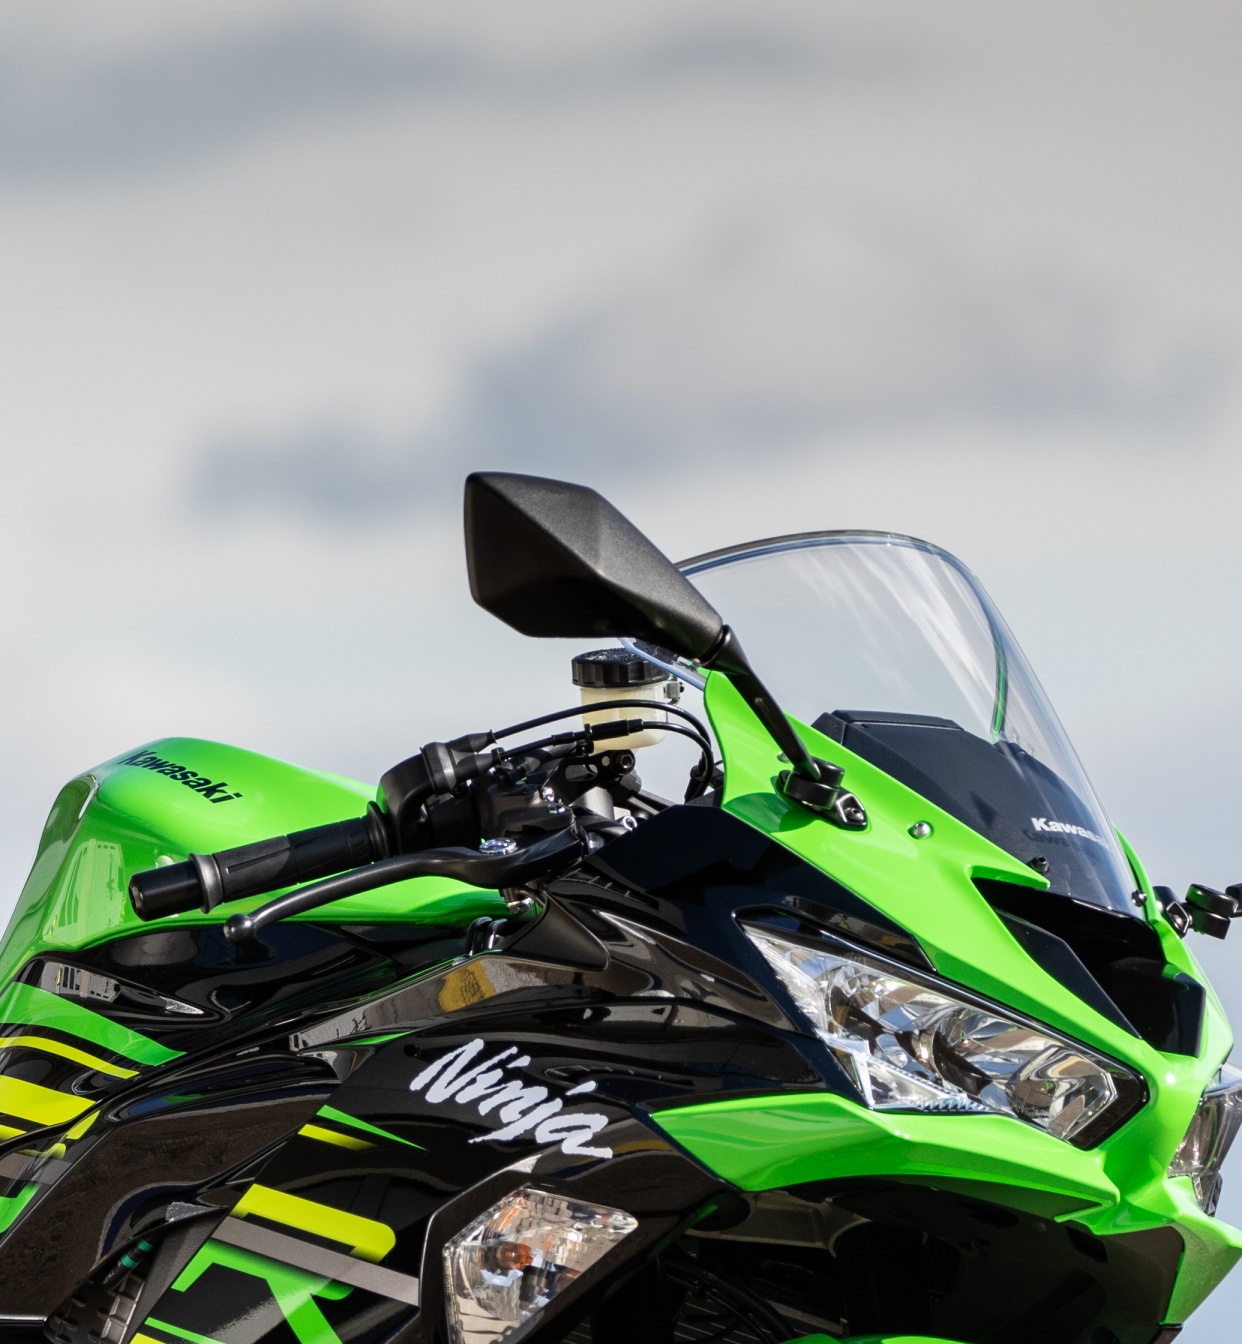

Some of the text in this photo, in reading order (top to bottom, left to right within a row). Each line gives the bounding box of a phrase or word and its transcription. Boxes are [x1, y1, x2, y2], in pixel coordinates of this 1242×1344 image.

[117, 750, 243, 803] Kawasaki
[1031, 817, 1106, 847] Kawasa
[410, 1038, 613, 1159] Ninja
